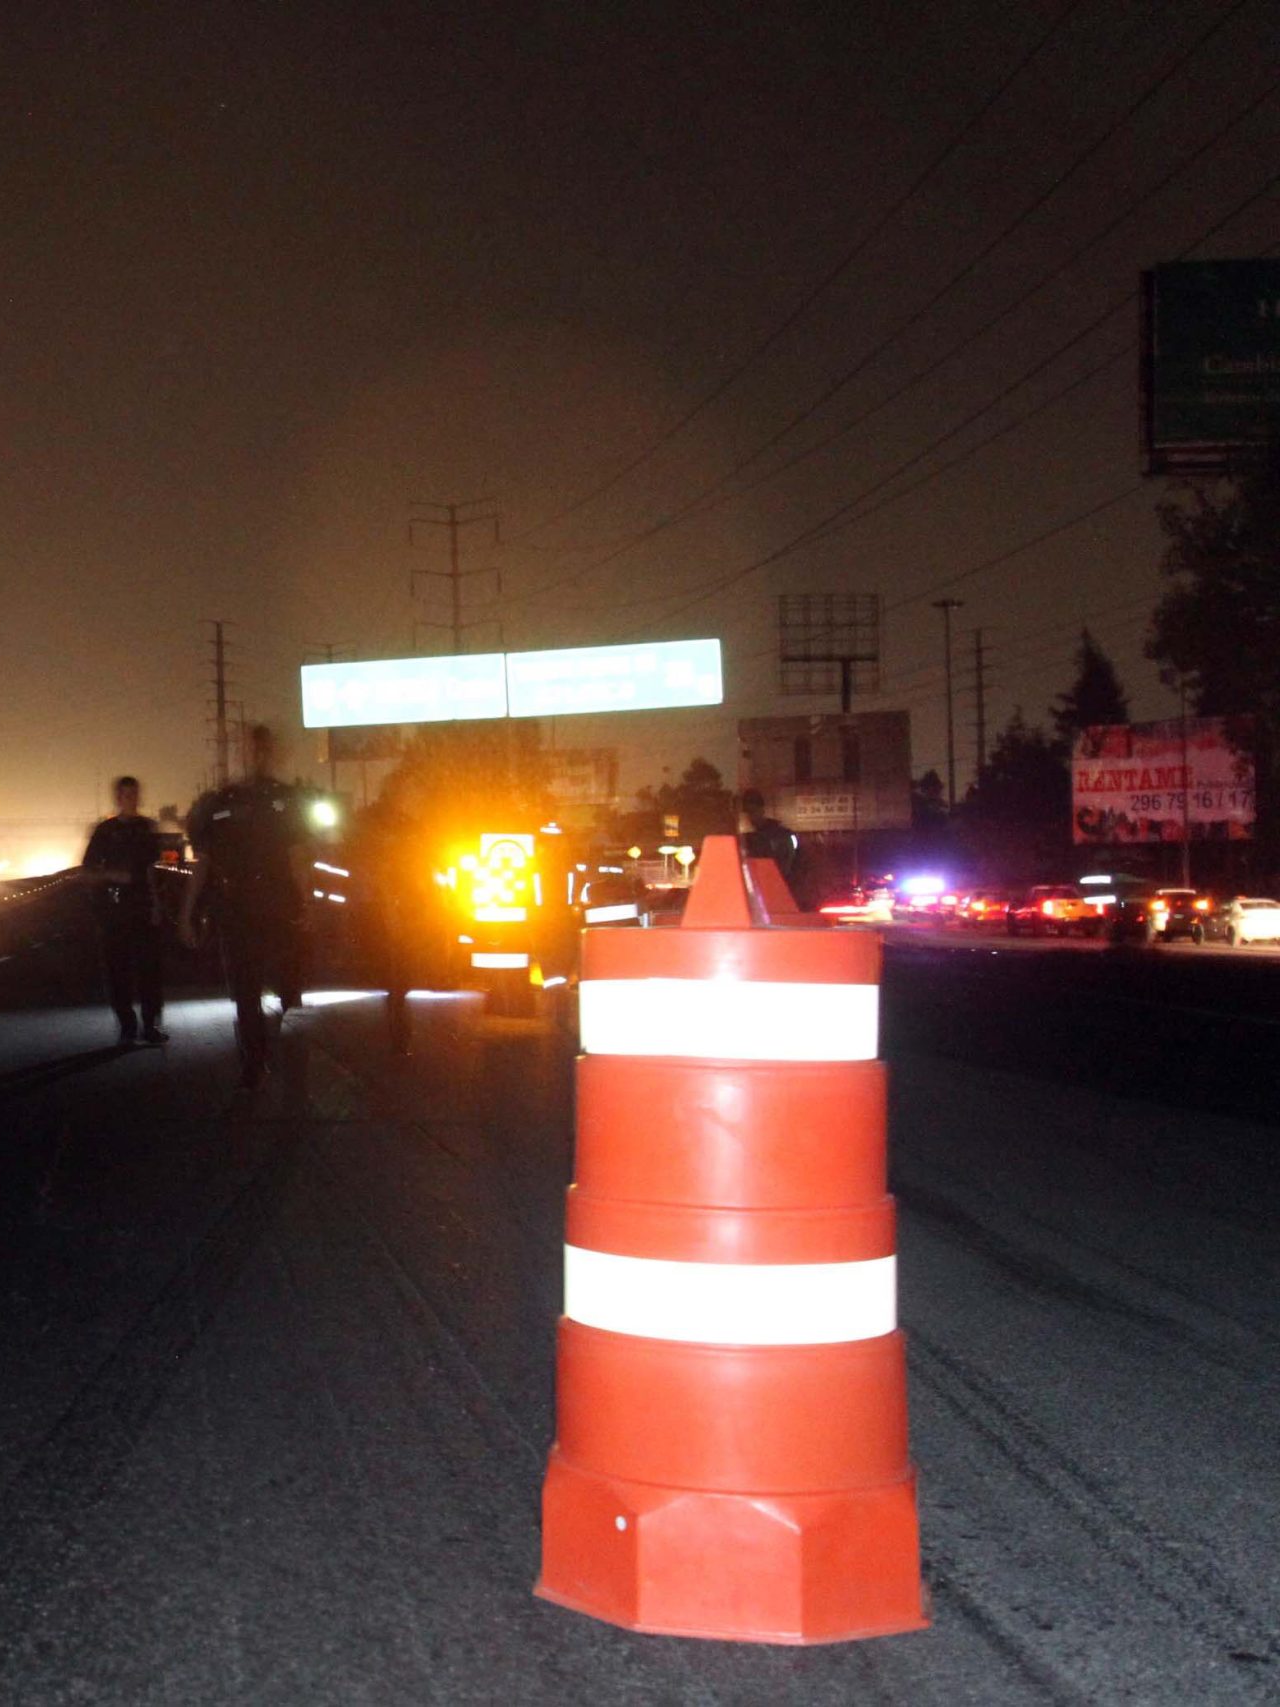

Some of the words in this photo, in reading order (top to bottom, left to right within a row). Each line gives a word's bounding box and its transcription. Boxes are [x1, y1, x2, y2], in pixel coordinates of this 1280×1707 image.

[1130, 793, 1162, 812] 296
[1166, 792, 1186, 811] 79
[1193, 791, 1214, 809] 16
[1228, 790, 1251, 808] 17
